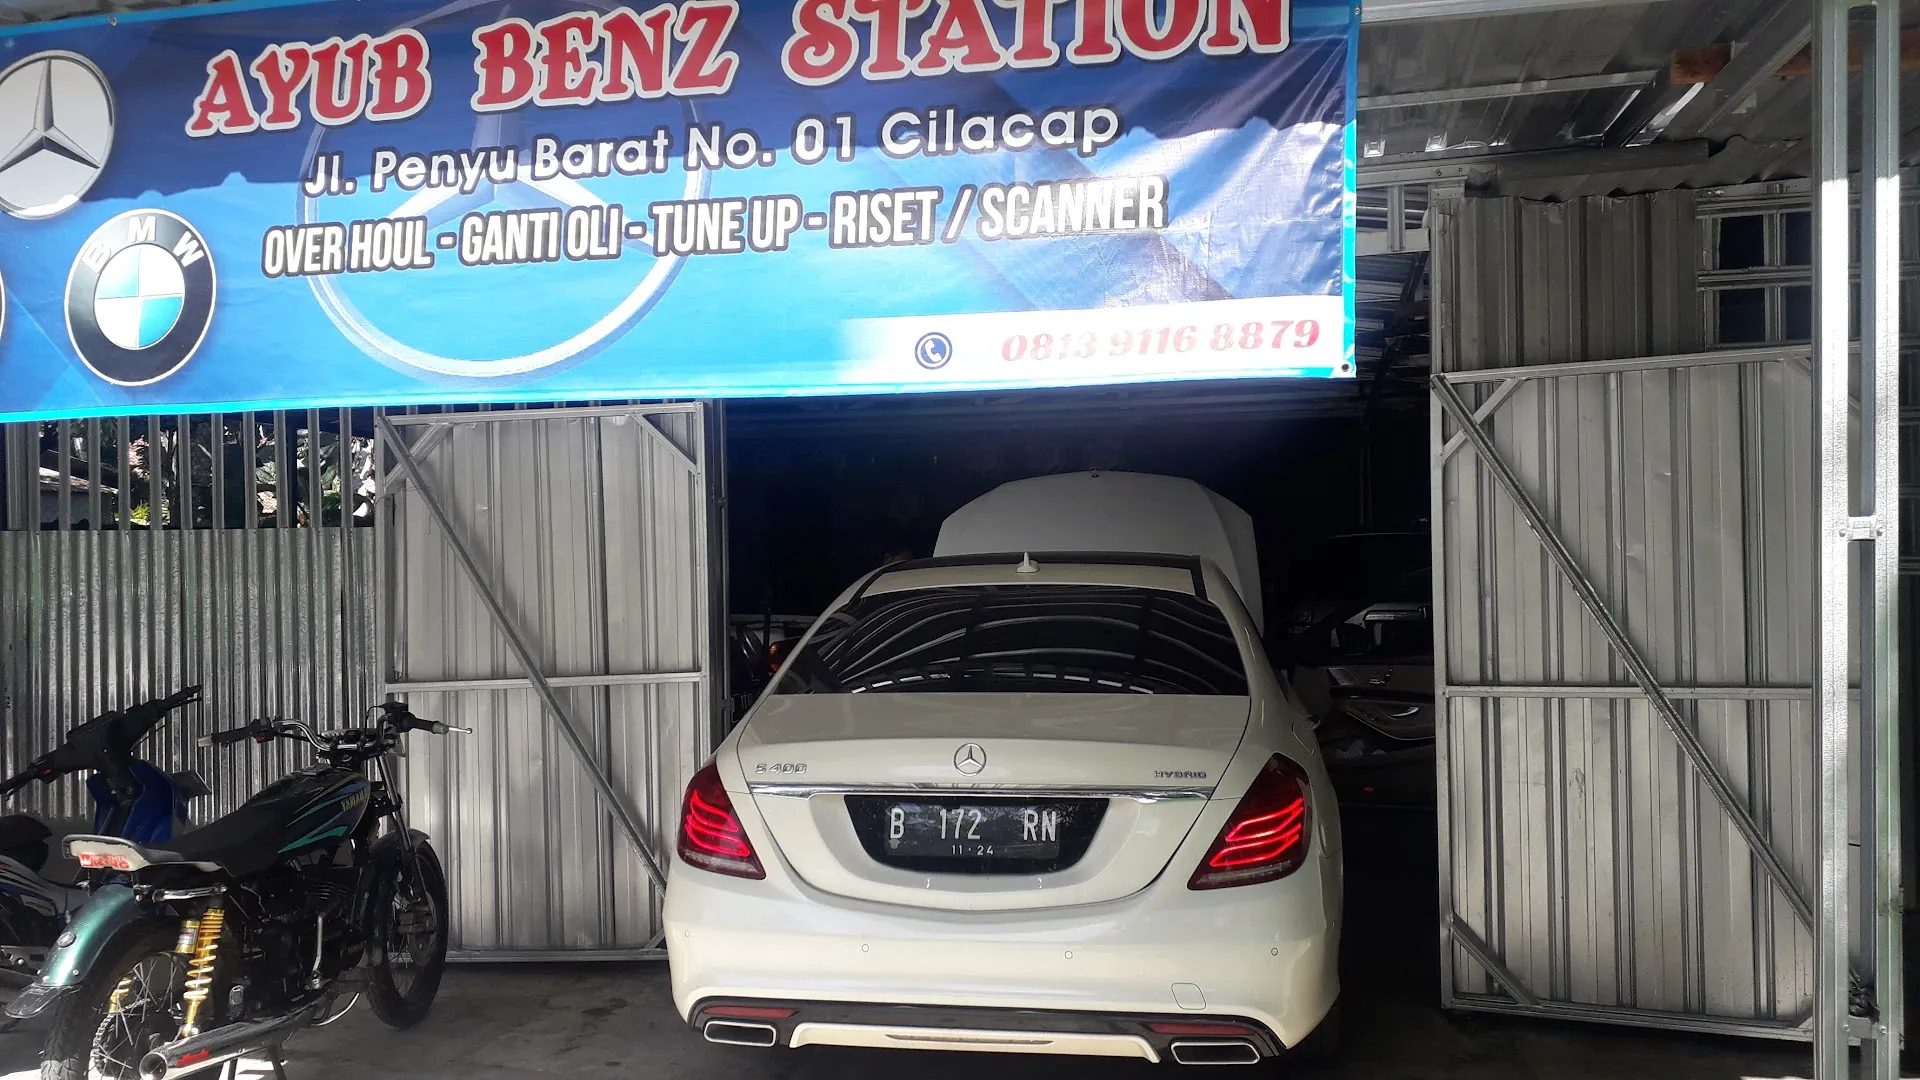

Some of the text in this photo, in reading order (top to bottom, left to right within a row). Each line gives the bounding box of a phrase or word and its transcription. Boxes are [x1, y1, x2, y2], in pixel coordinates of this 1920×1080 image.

[186, 0, 1290, 137] AYUB BENZ STATION
[305, 107, 1120, 195] Jl. Penyu Barat No. 01 Cilacap
[264, 224, 346, 276] OVER
[350, 219, 432, 269] HOUL
[462, 210, 559, 264] GANTI
[567, 206, 622, 256] OLI
[653, 200, 744, 253] TUNE
[751, 198, 799, 249] UP
[832, 190, 939, 244] RISET
[979, 177, 1165, 238] SCANNER
[1001, 319, 1320, 361] 0813 9116 8879
[1153, 770, 1207, 779] HYBRID
[889, 807, 1057, 842] B 172 RN
